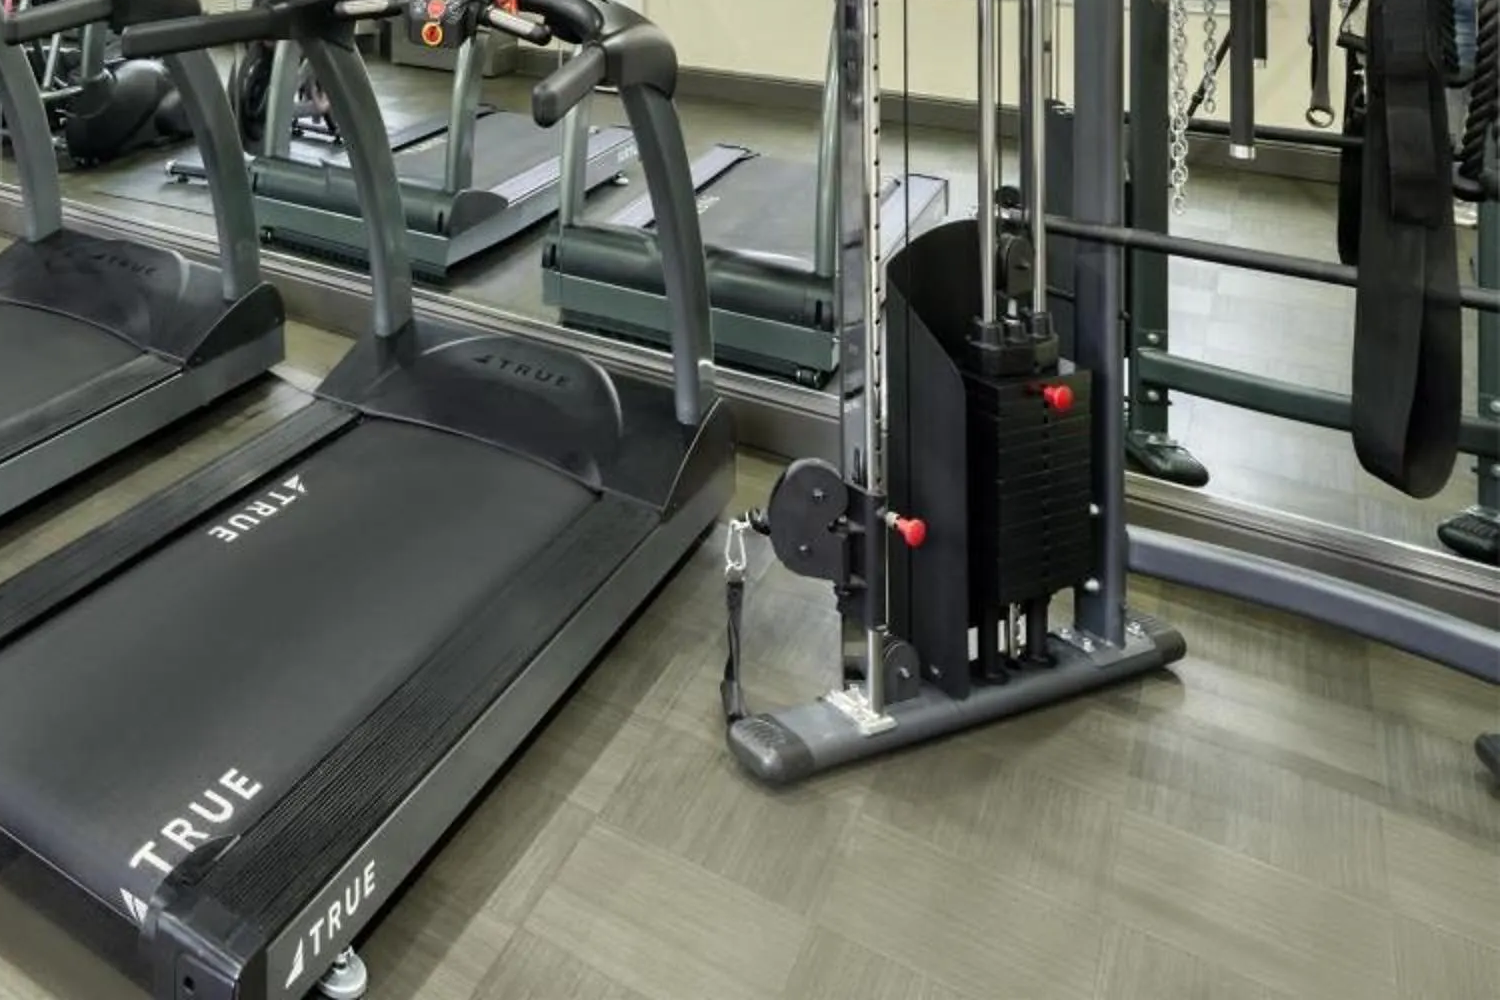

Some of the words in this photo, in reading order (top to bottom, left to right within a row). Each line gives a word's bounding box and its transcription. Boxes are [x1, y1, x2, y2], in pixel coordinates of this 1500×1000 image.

[498, 359, 570, 387] TRUE
[207, 491, 297, 543] TRUE
[128, 767, 263, 874] TRUE
[309, 859, 376, 956] TRUE
